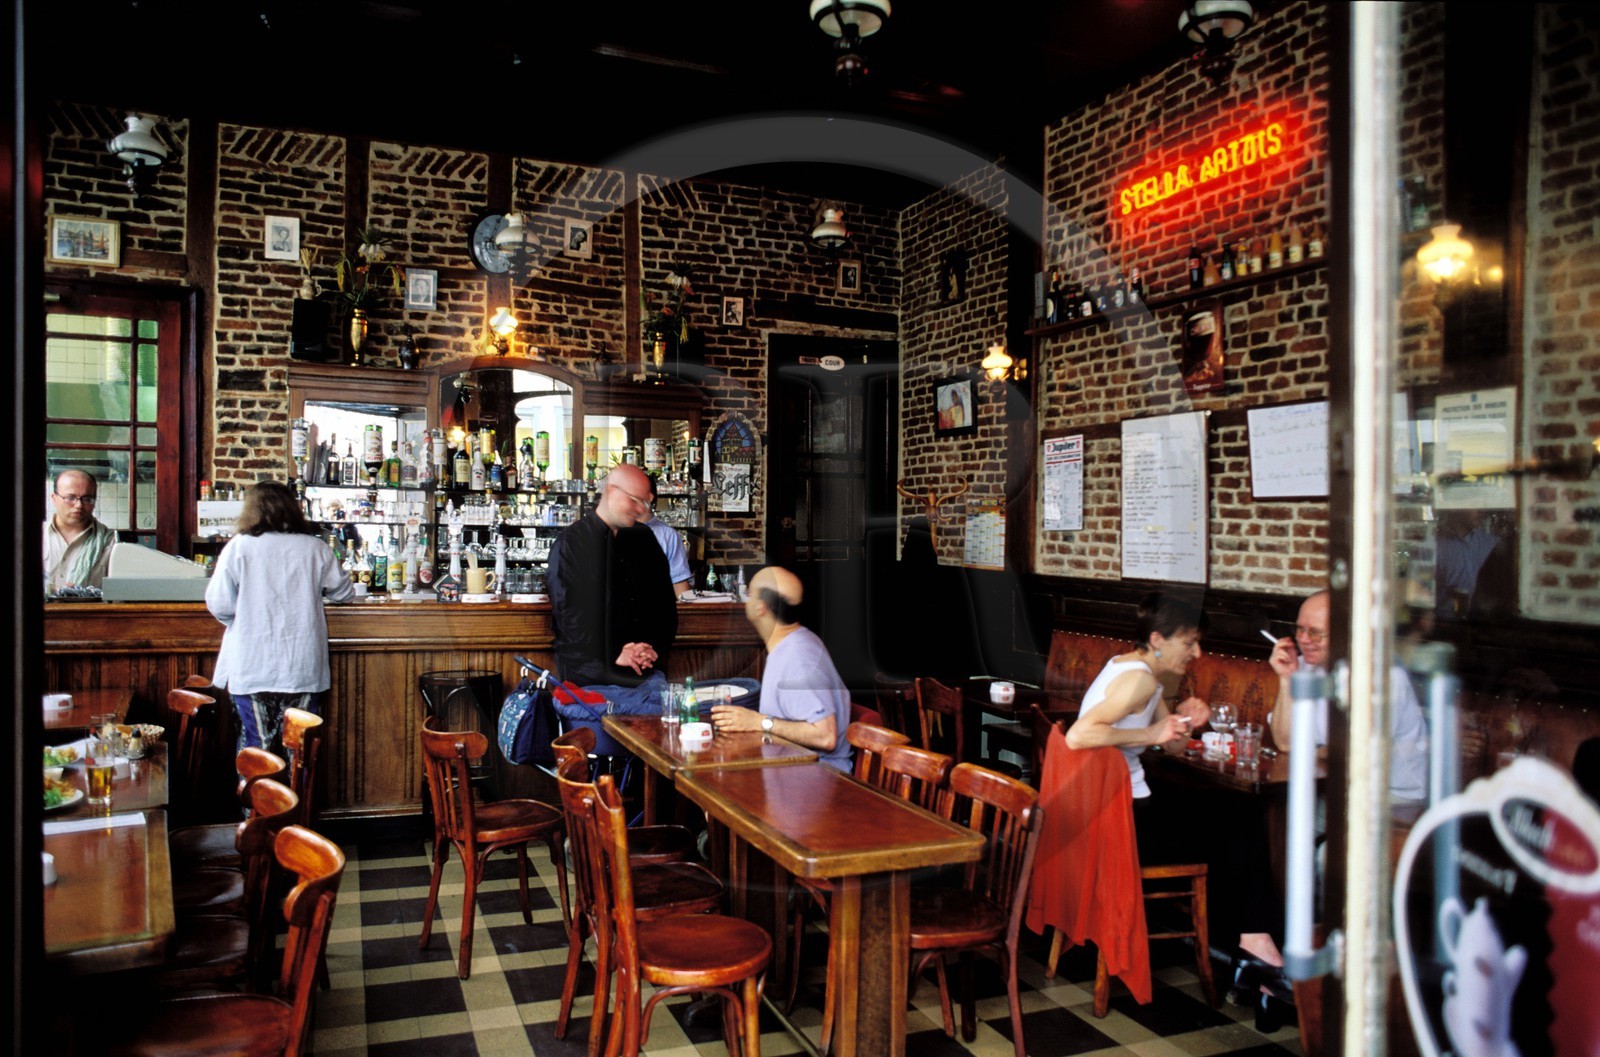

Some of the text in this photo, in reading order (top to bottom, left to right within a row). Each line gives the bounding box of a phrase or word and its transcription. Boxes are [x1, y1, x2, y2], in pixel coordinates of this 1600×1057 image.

[1120, 122, 1283, 215] STELLA ARTOIS
[1052, 442, 1075, 452] Jupiler
[709, 472, 759, 500] Leffe
